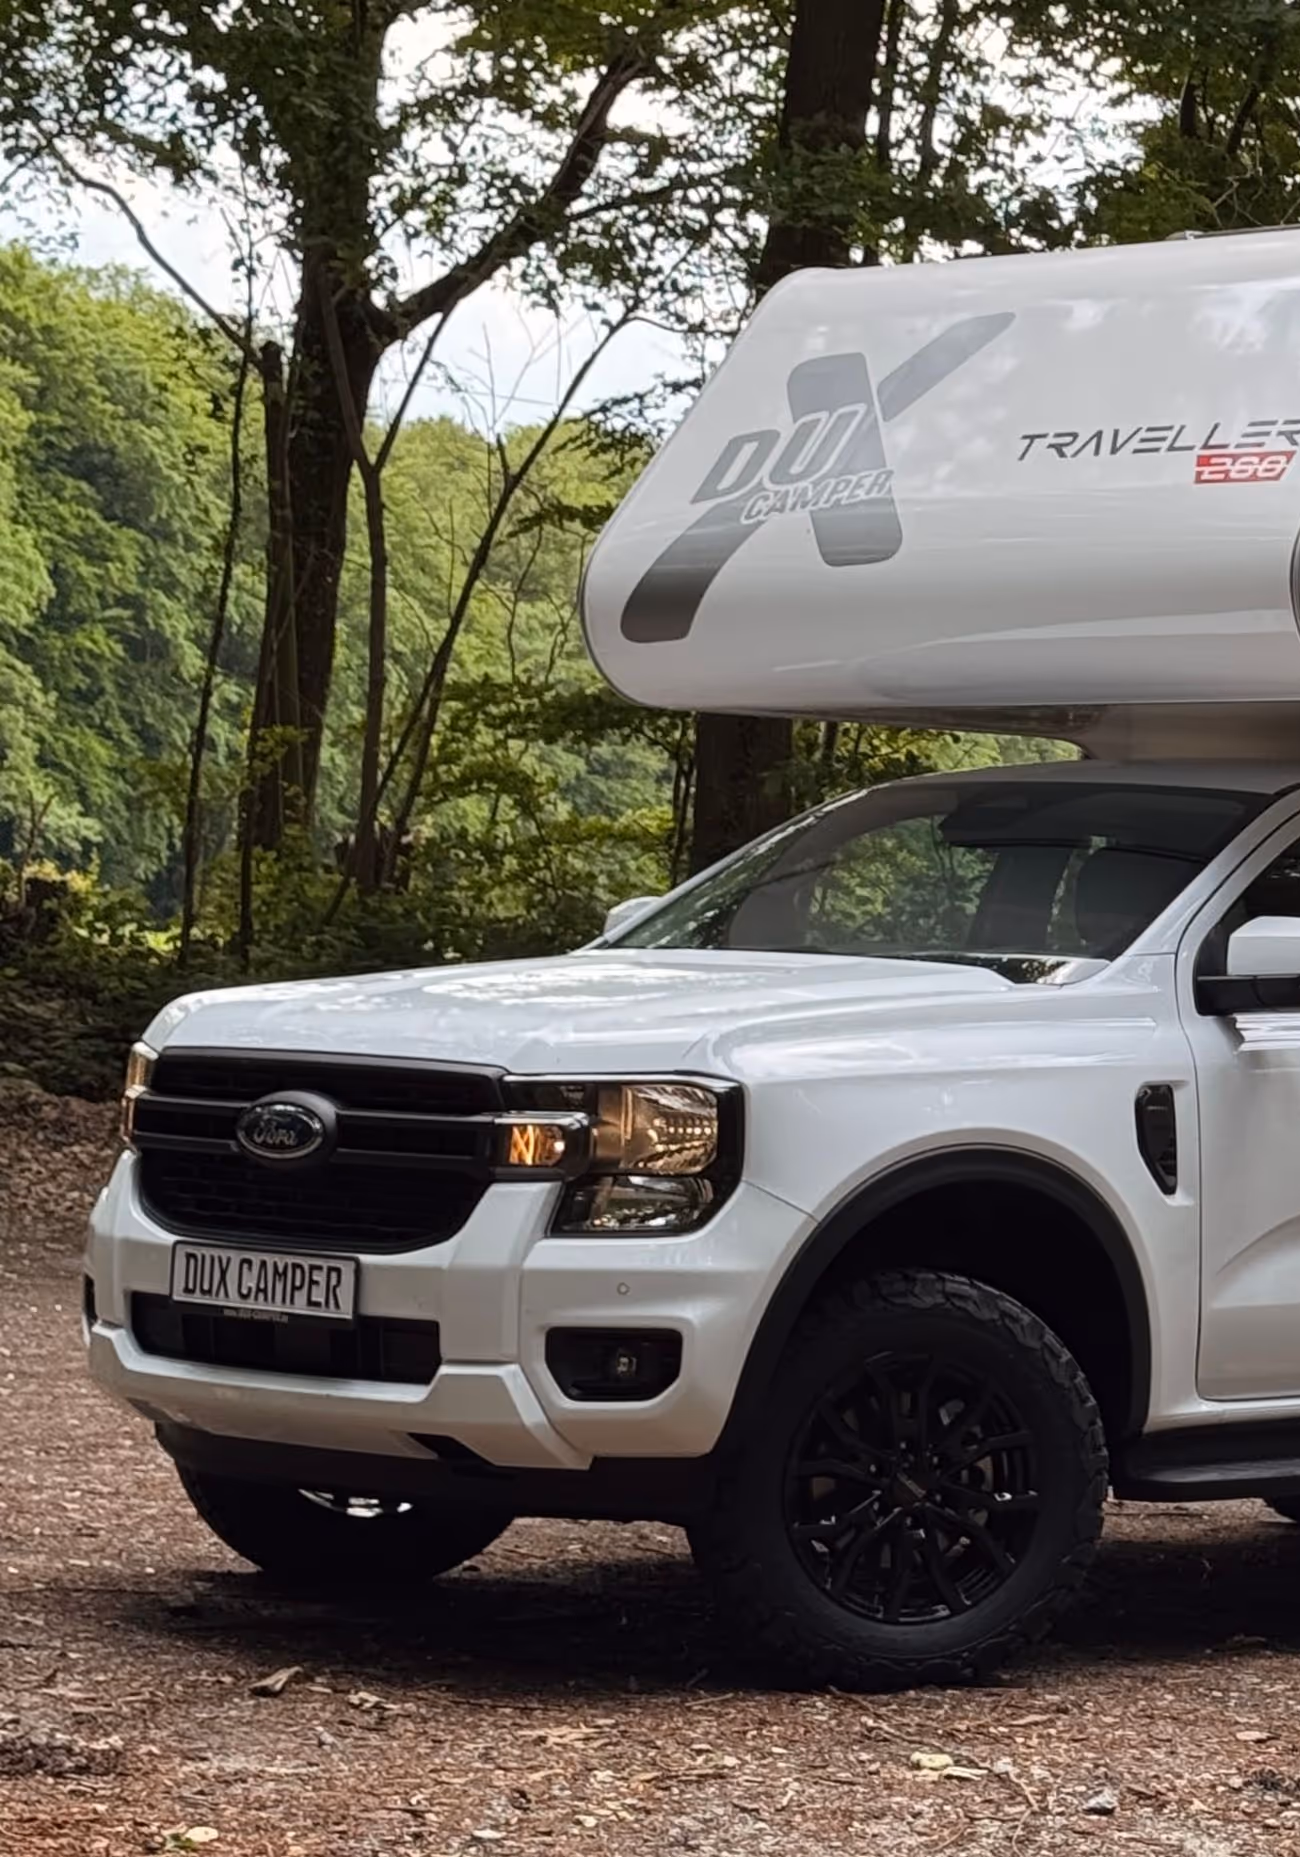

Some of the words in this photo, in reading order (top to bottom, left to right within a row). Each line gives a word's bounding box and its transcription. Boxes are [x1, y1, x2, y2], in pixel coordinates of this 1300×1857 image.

[743, 469, 893, 523] CAMPER
[182, 1251, 232, 1299] DUX
[236, 1256, 343, 1311] CAMPER
